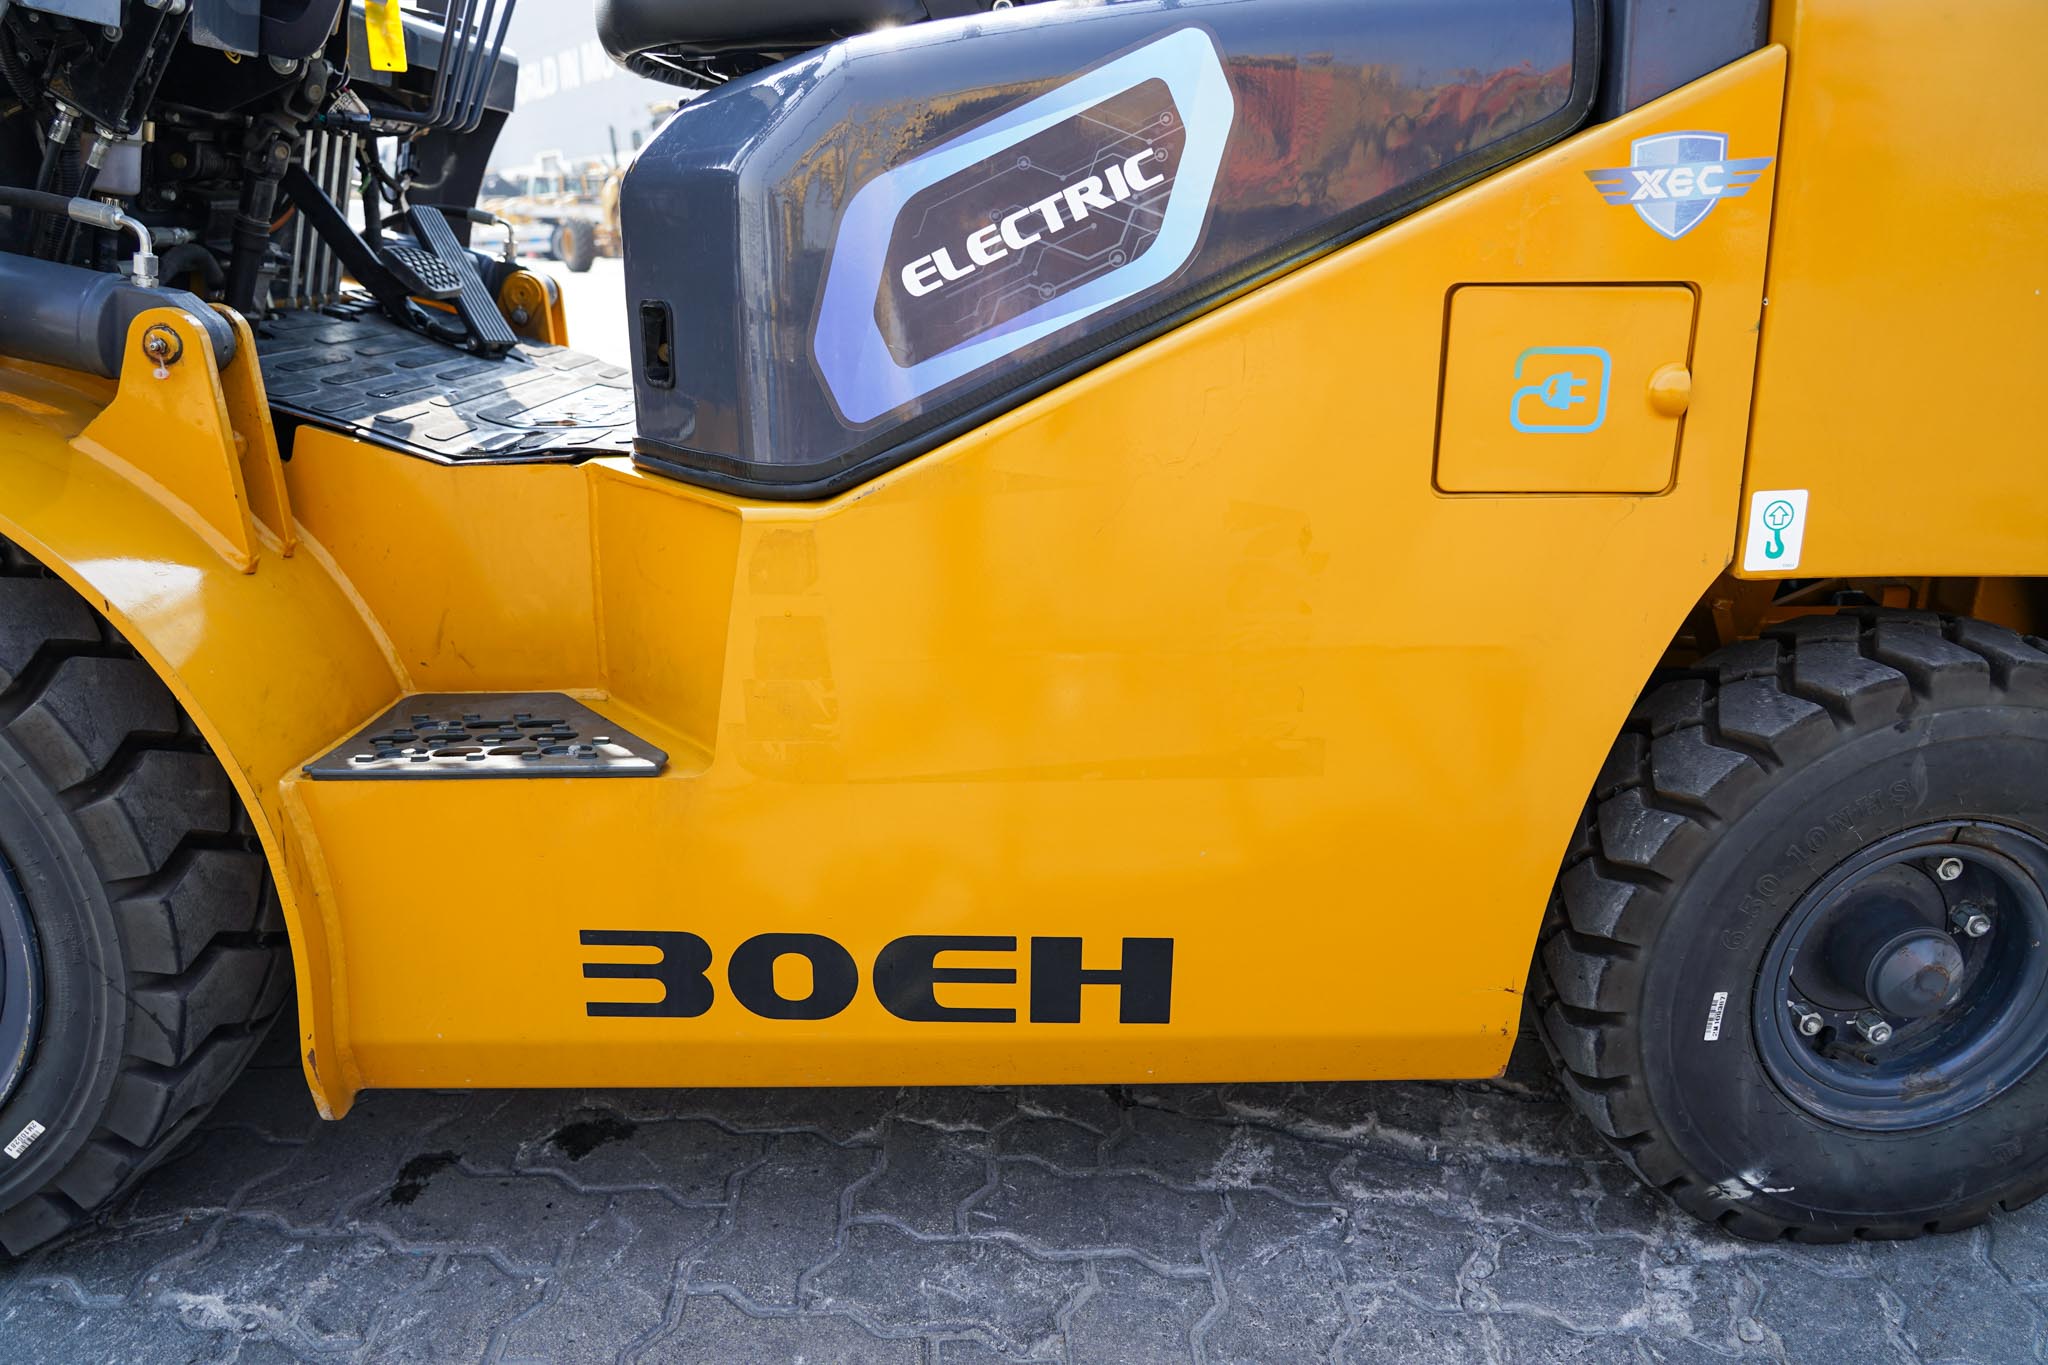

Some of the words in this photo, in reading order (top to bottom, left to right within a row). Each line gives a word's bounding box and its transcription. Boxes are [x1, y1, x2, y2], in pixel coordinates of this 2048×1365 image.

[900, 147, 1165, 298] ELECTRIC
[1630, 165, 1725, 201] XEC
[579, 929, 1174, 1024] 30EH
